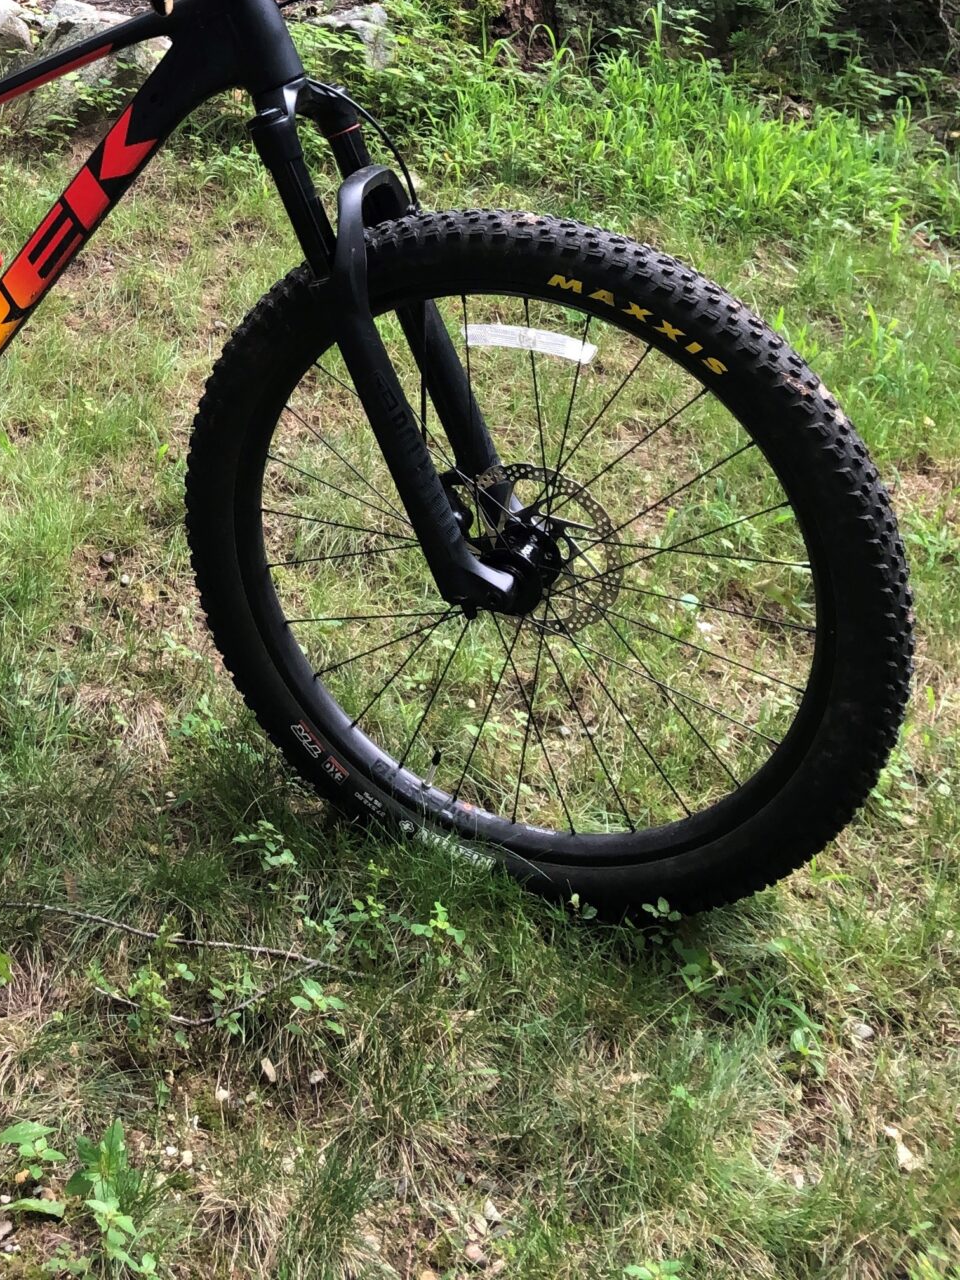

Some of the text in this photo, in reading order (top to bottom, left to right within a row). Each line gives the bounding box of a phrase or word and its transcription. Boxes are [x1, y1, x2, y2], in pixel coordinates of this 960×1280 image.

[547, 274, 728, 375] MAXXIS
[290, 724, 322, 758] TR
[323, 760, 345, 782] EXO
